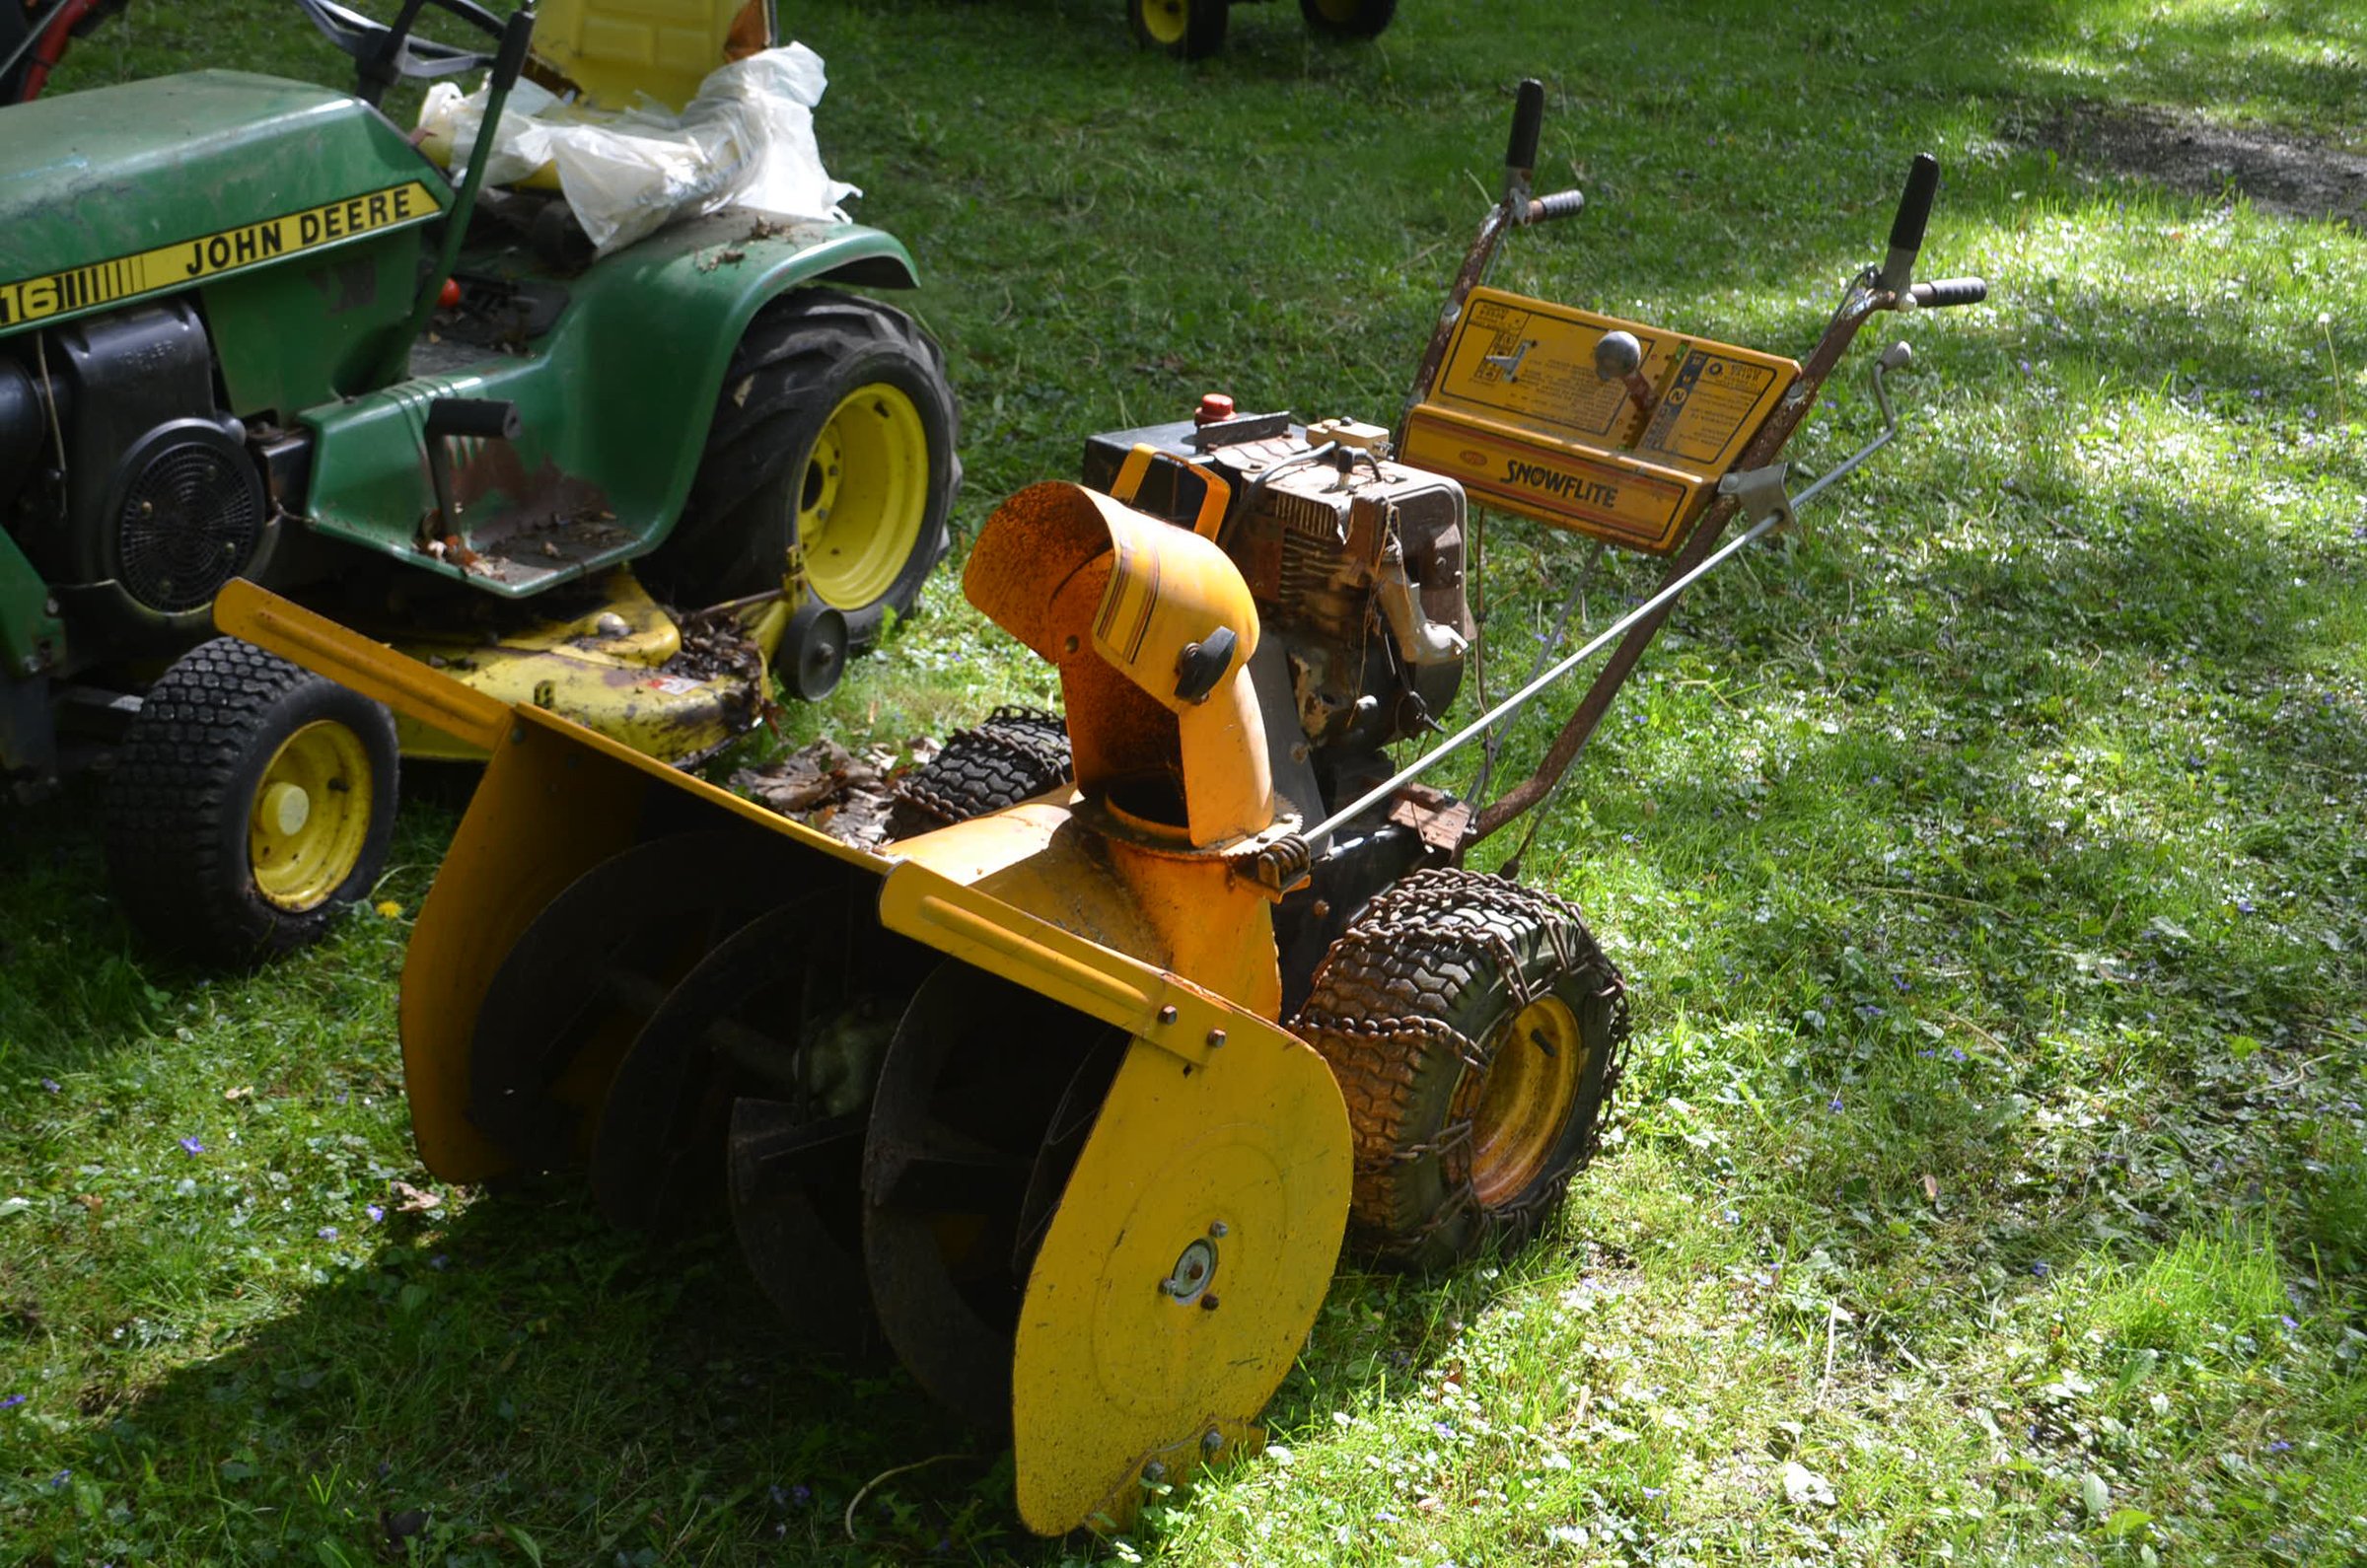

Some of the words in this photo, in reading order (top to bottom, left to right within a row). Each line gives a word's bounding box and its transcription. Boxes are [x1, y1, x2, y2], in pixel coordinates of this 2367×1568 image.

[186, 222, 282, 275] JOHN
[300, 189, 410, 245] DEERE
[1499, 459, 1618, 508] SNOWFLITE
